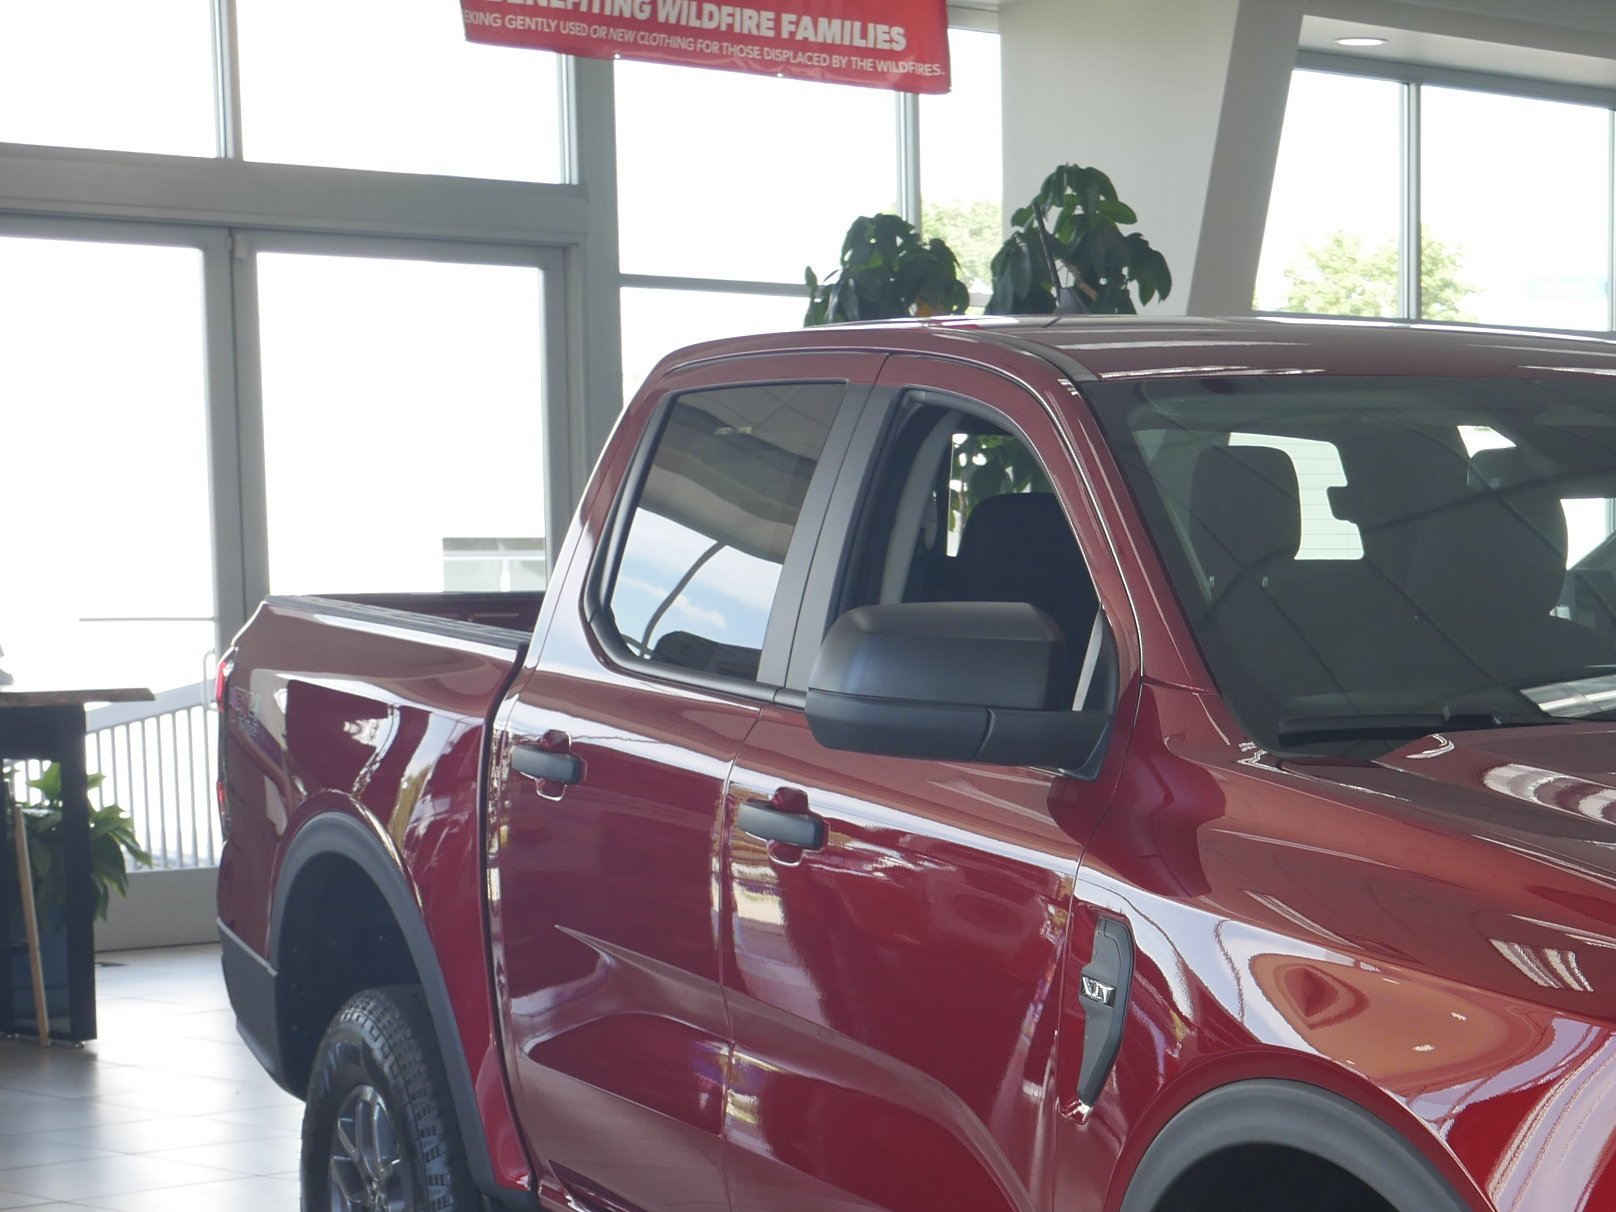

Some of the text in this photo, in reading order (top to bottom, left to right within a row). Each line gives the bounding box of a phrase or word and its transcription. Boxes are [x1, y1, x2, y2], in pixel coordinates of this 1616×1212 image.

[505, 15, 558, 33] GENTLY
[559, 21, 588, 37] USED
[590, 25, 607, 40] OR
[608, 28, 635, 43] NEW
[637, 31, 695, 51] CLOTHING
[697, 39, 723, 54] FOR
[722, 42, 761, 59] THOSE
[764, 48, 830, 67] DISPLACED
[832, 55, 848, 68] BY
[850, 57, 876, 72] THE
[876, 60, 946, 77] WILDFIRES.
[656, 0, 775, 37] WILDFIRE
[781, 13, 907, 51] FAMILIES
